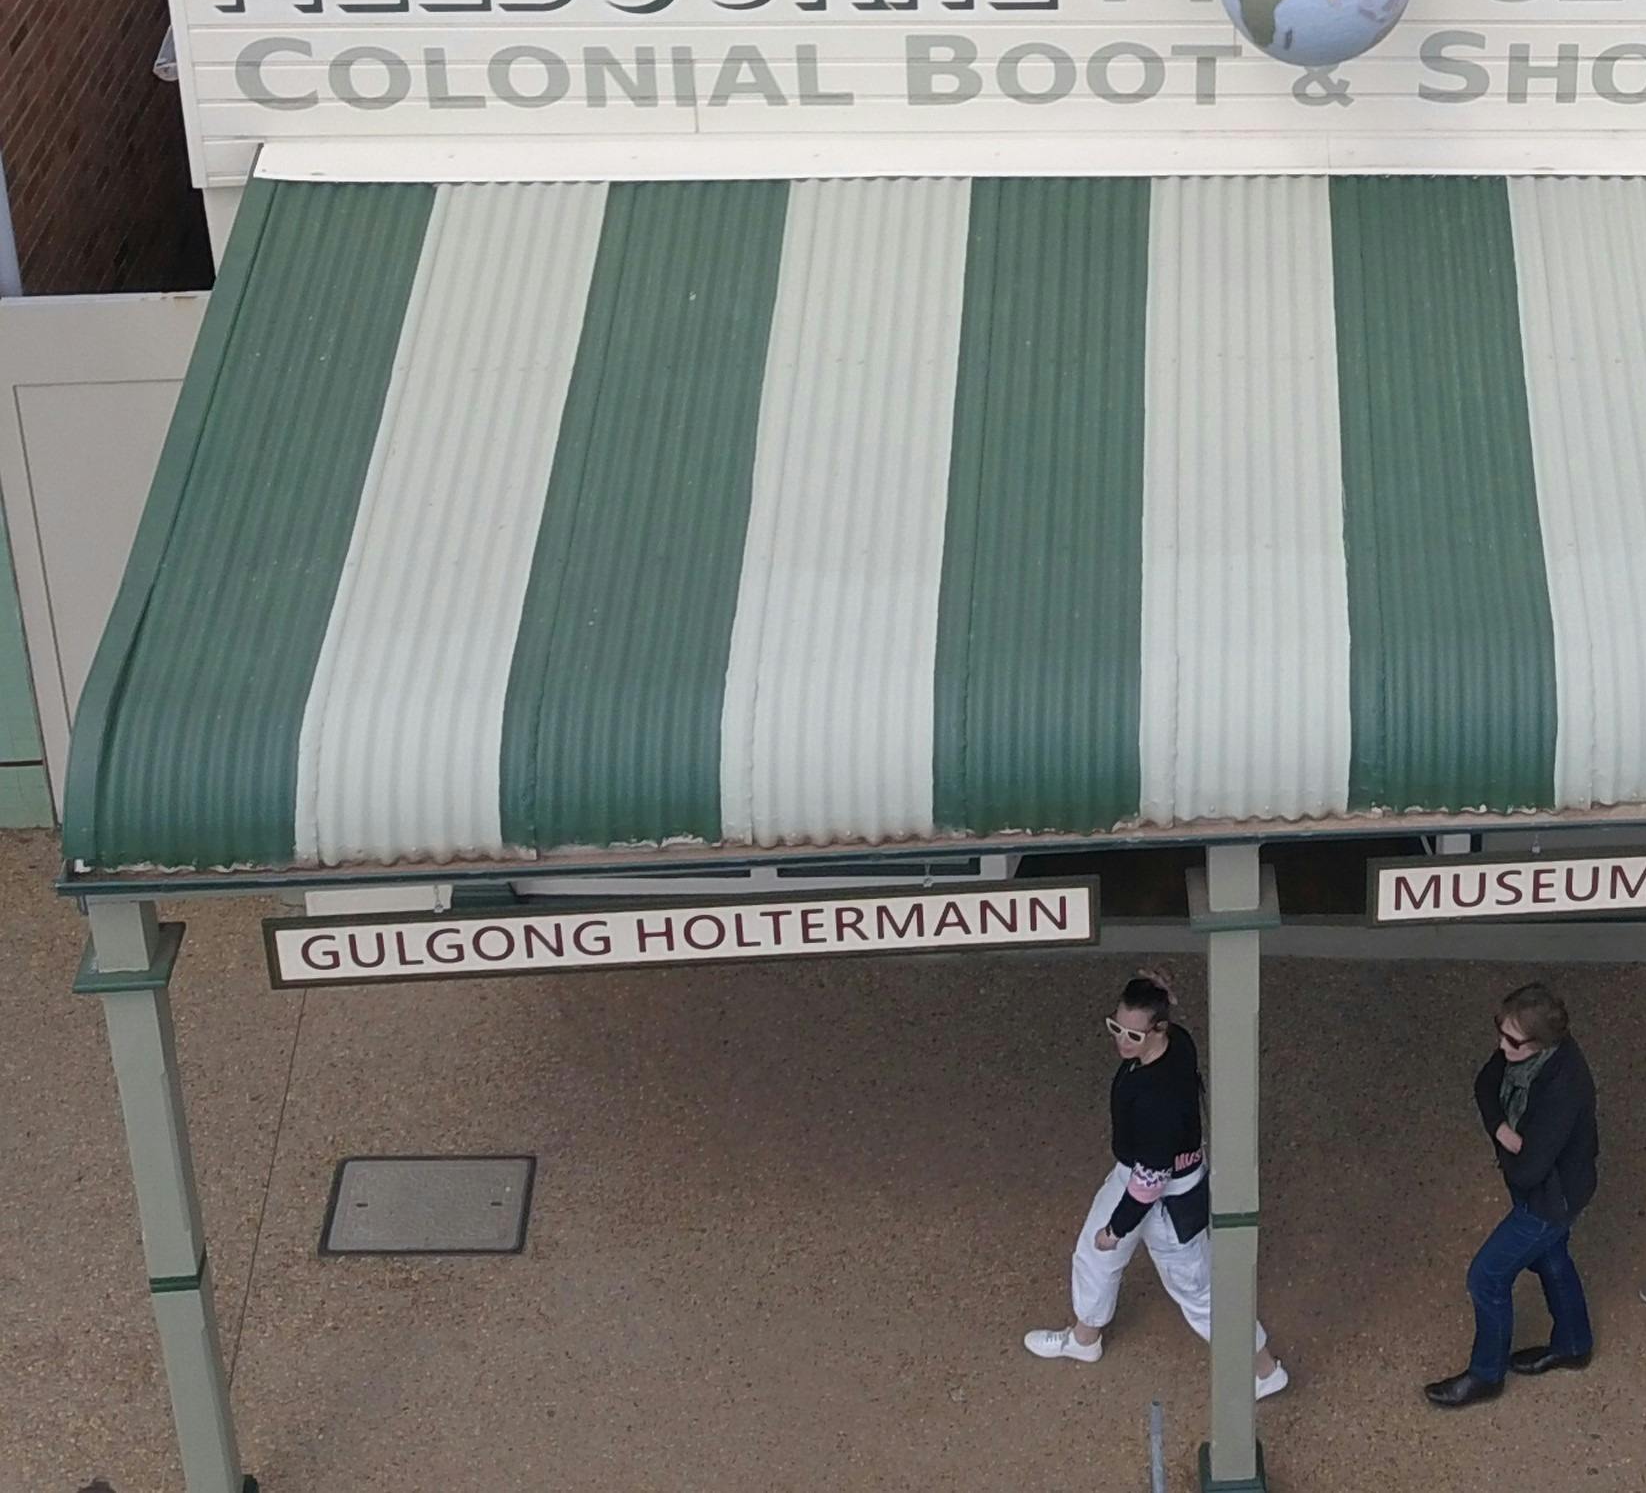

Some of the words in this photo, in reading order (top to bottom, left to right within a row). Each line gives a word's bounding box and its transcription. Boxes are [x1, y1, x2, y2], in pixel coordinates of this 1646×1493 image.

[234, 37, 854, 109] COLONIAL
[906, 33, 1243, 105] BOOT
[301, 917, 612, 971] GULGONG
[636, 894, 1070, 954] HOLTERMANN
